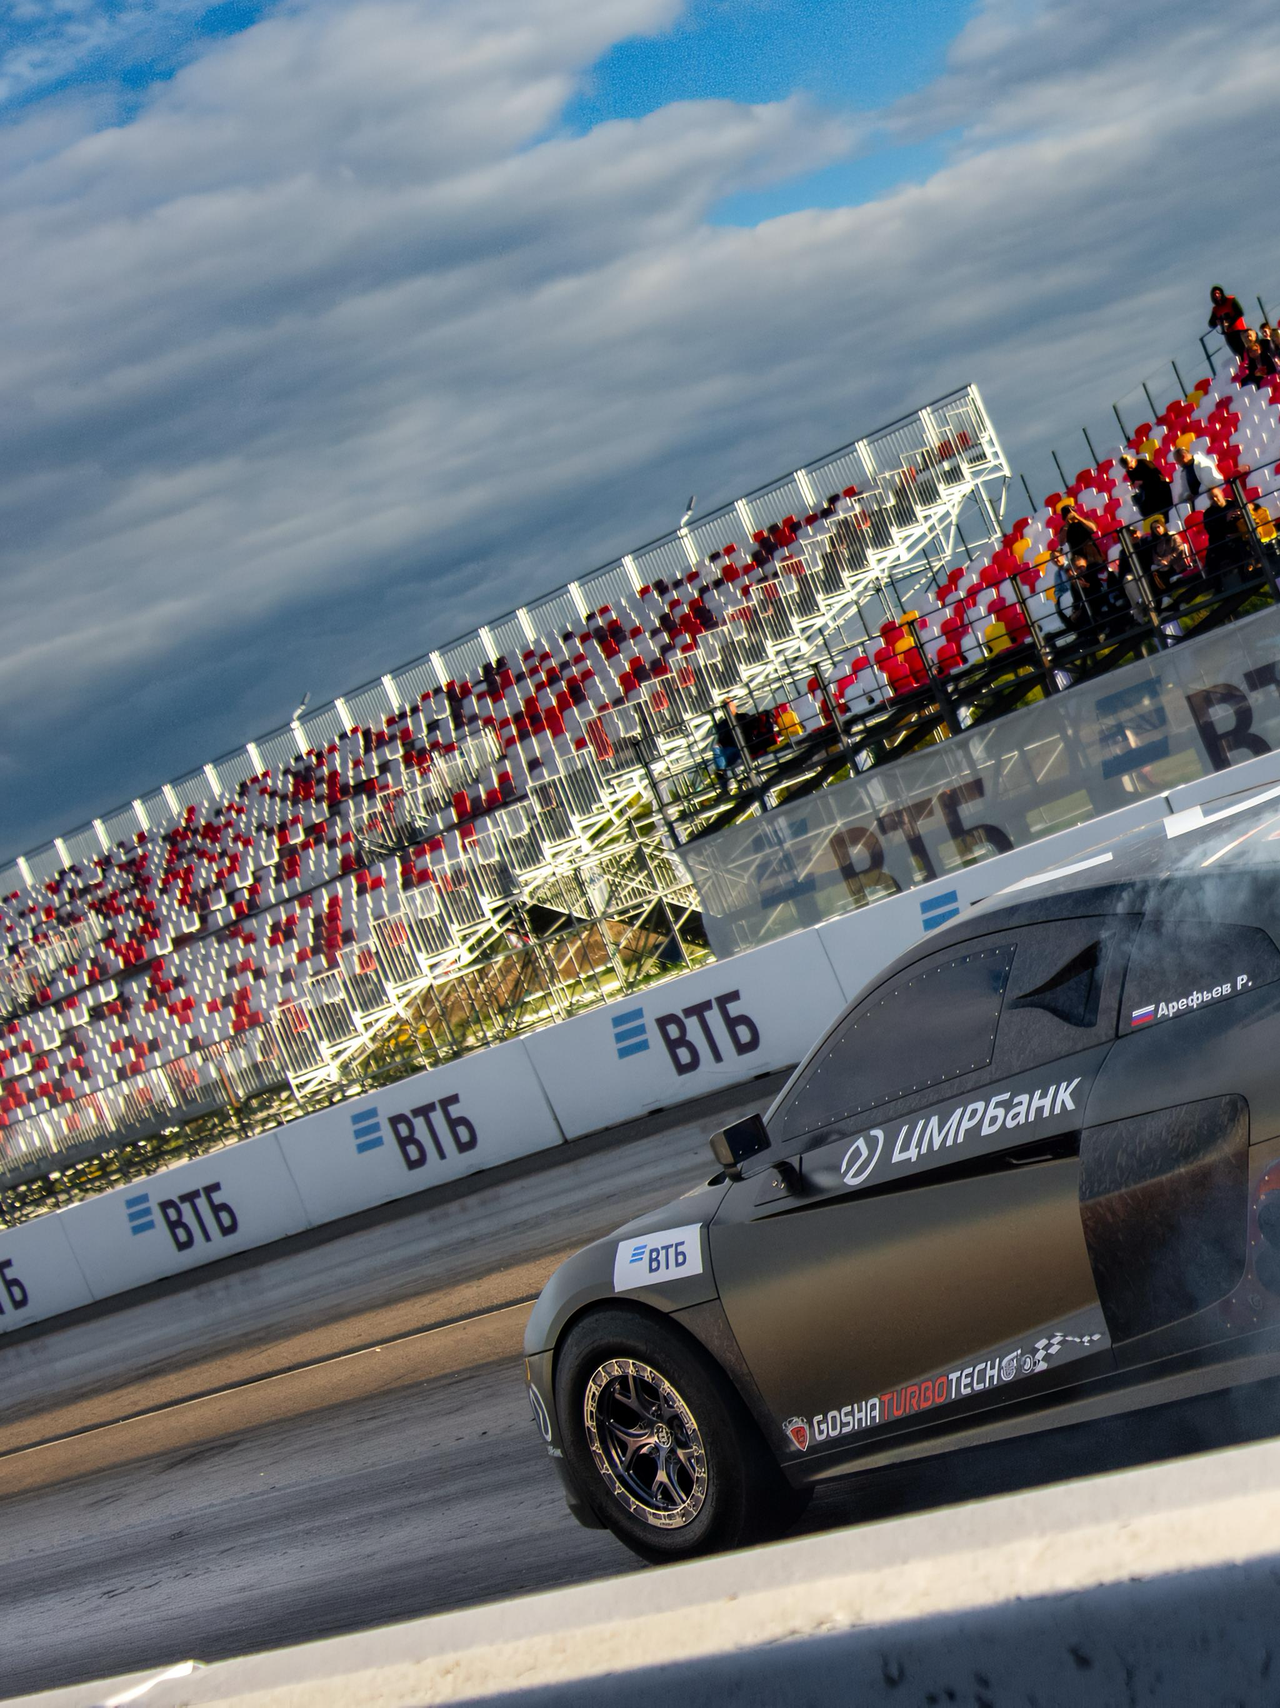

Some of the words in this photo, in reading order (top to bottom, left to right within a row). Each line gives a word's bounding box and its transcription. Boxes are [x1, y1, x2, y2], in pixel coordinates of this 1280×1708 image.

[655, 989, 761, 1077] ВТБ
[1157, 982, 1232, 1018] Арефьев
[1236, 974, 1253, 991] Р.
[387, 1093, 478, 1171] ВТБ
[890, 1076, 1082, 1165] ЦМРБанк
[158, 1181, 239, 1253] ВТБ
[648, 1240, 688, 1275] ВТБ
